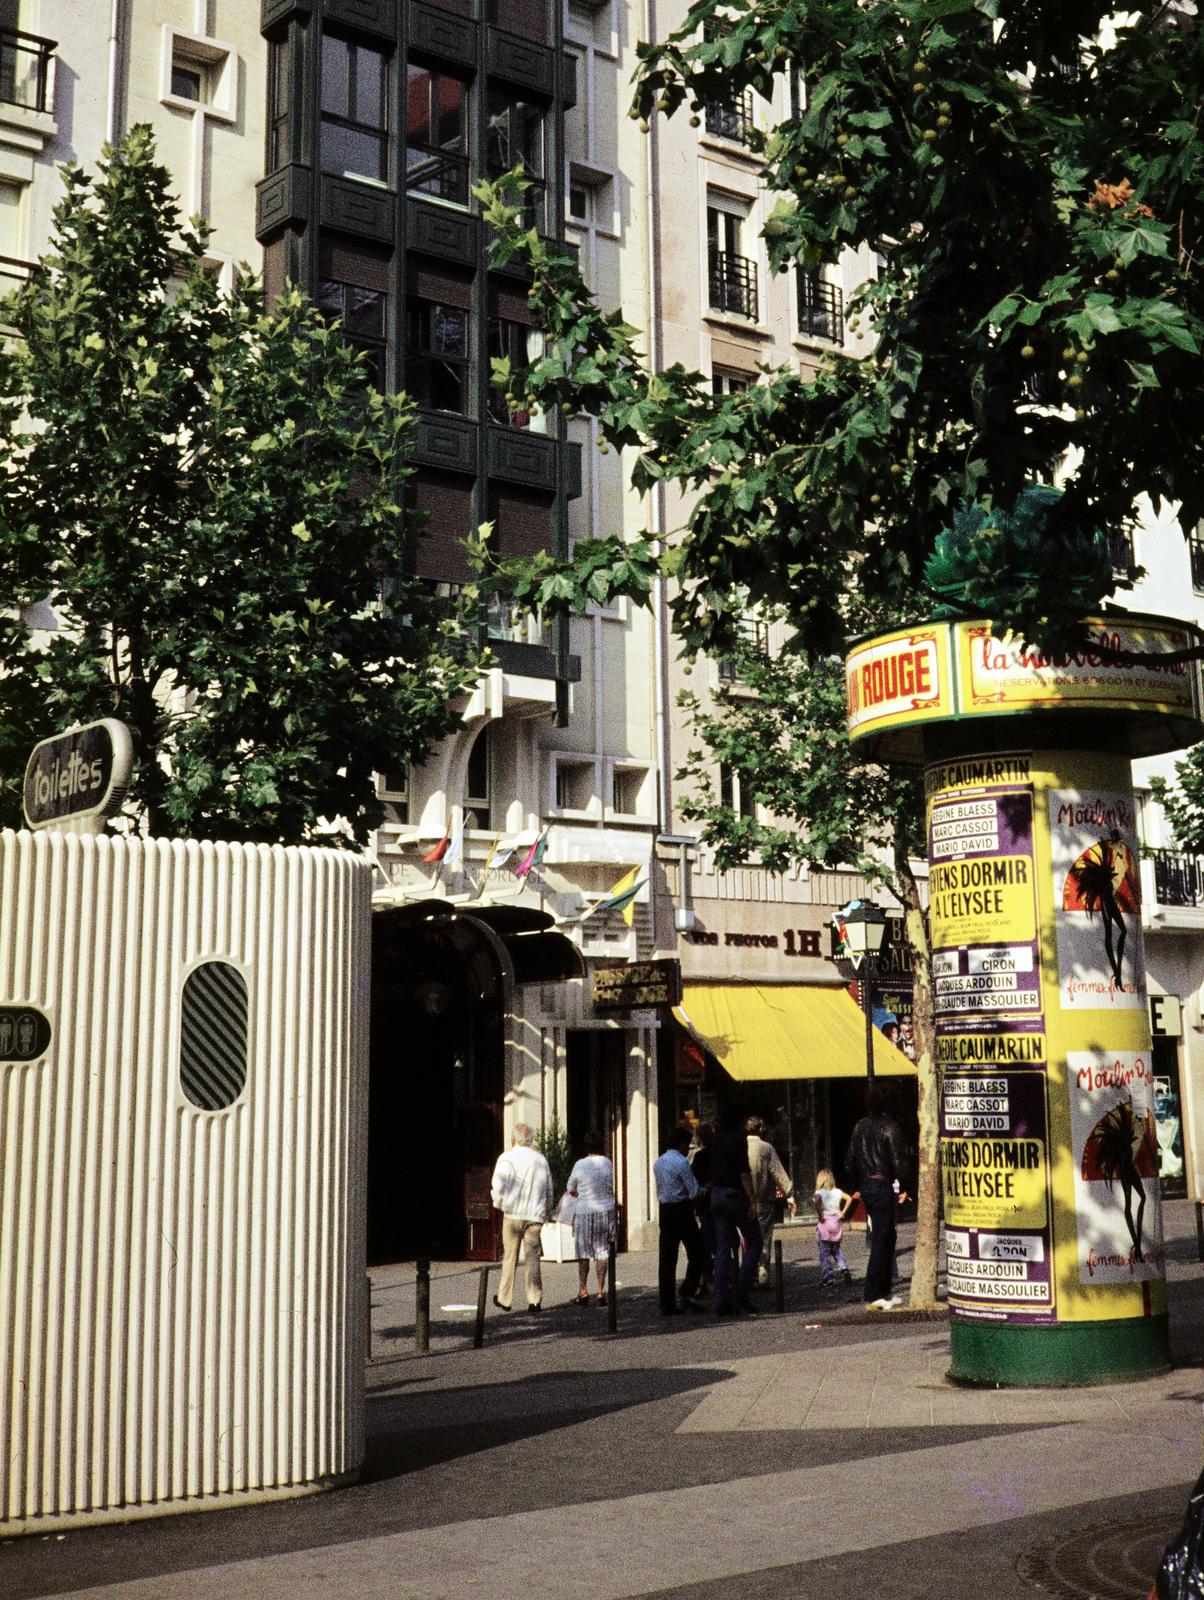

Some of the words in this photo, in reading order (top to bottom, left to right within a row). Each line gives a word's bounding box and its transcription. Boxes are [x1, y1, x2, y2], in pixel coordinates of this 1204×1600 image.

[980, 638, 1009, 671] la
[862, 649, 931, 708] ROUGE
[34, 750, 102, 806] toilettes
[948, 760, 1030, 788] CAUMARTIN
[957, 803, 994, 818] BLAESS
[934, 825, 953, 838] MARC
[955, 820, 995, 834] CASSOT
[935, 842, 958, 855] MARIO
[961, 838, 993, 852] DAVID
[961, 860, 1028, 888] DORMIR
[724, 932, 779, 949] PHOTOS
[783, 929, 822, 957] 1H
[981, 959, 1016, 972] CIRON
[966, 976, 1013, 989] ARDOUIN
[968, 993, 1037, 1008] MASSOULIER
[960, 1037, 1042, 1061] CAUMARTIN
[1076, 1059, 1134, 1092] Moulin
[944, 1081, 966, 1093] REGINE
[968, 1081, 1006, 1093] BLAESS
[945, 1100, 965, 1111] MARC
[966, 1099, 1006, 1111] CASSOT
[972, 1117, 1005, 1129] DAVID
[972, 1141, 1040, 1169] DORMIR
[976, 1264, 1023, 1277] ARDOUIN
[978, 1282, 1048, 1297] MASSOULIER
